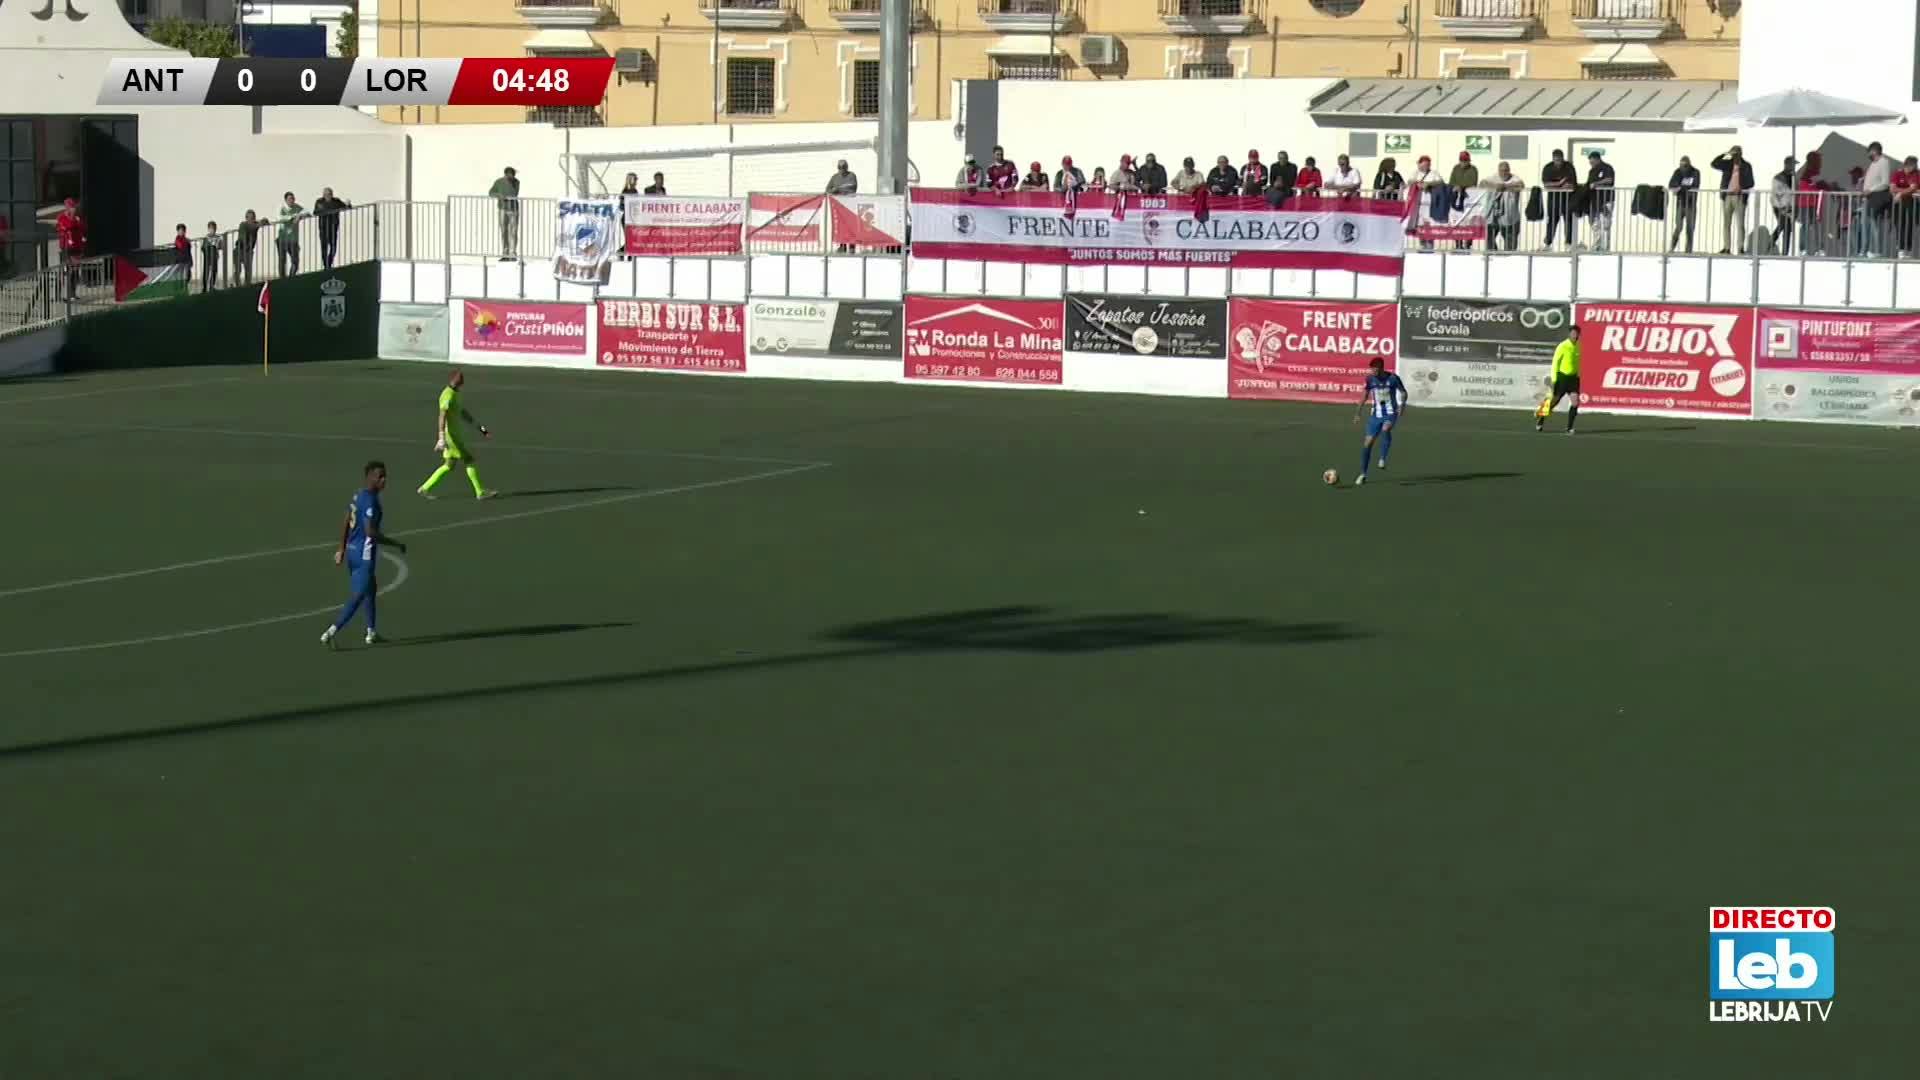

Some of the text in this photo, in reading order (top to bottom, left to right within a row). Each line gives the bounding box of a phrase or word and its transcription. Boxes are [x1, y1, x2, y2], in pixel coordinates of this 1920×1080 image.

[642, 202, 741, 214] FRENTE CALABAZO
[1008, 215, 1320, 241] FRENTE CALABAZO
[1116, 250, 1155, 261] SOMOS
[506, 311, 545, 321] PINTURAS
[666, 303, 703, 330] SUR
[1086, 299, 1206, 329] Zapatos Jessica
[1303, 311, 1373, 330] FRENTE
[1427, 306, 1513, 323] federópticos
[1584, 308, 1670, 324] PINTURAS
[638, 329, 698, 344] Transporte y
[1802, 320, 1872, 337] PINTUFONT
[932, 330, 988, 348] Ronda
[994, 331, 1015, 349] La
[1020, 333, 1062, 350] Mina
[1285, 334, 1394, 355] CALABAZO
[619, 342, 724, 357] Movimiento de Tierra
[932, 348, 986, 359] Promociones
[1614, 370, 1689, 388] TITANPRO
